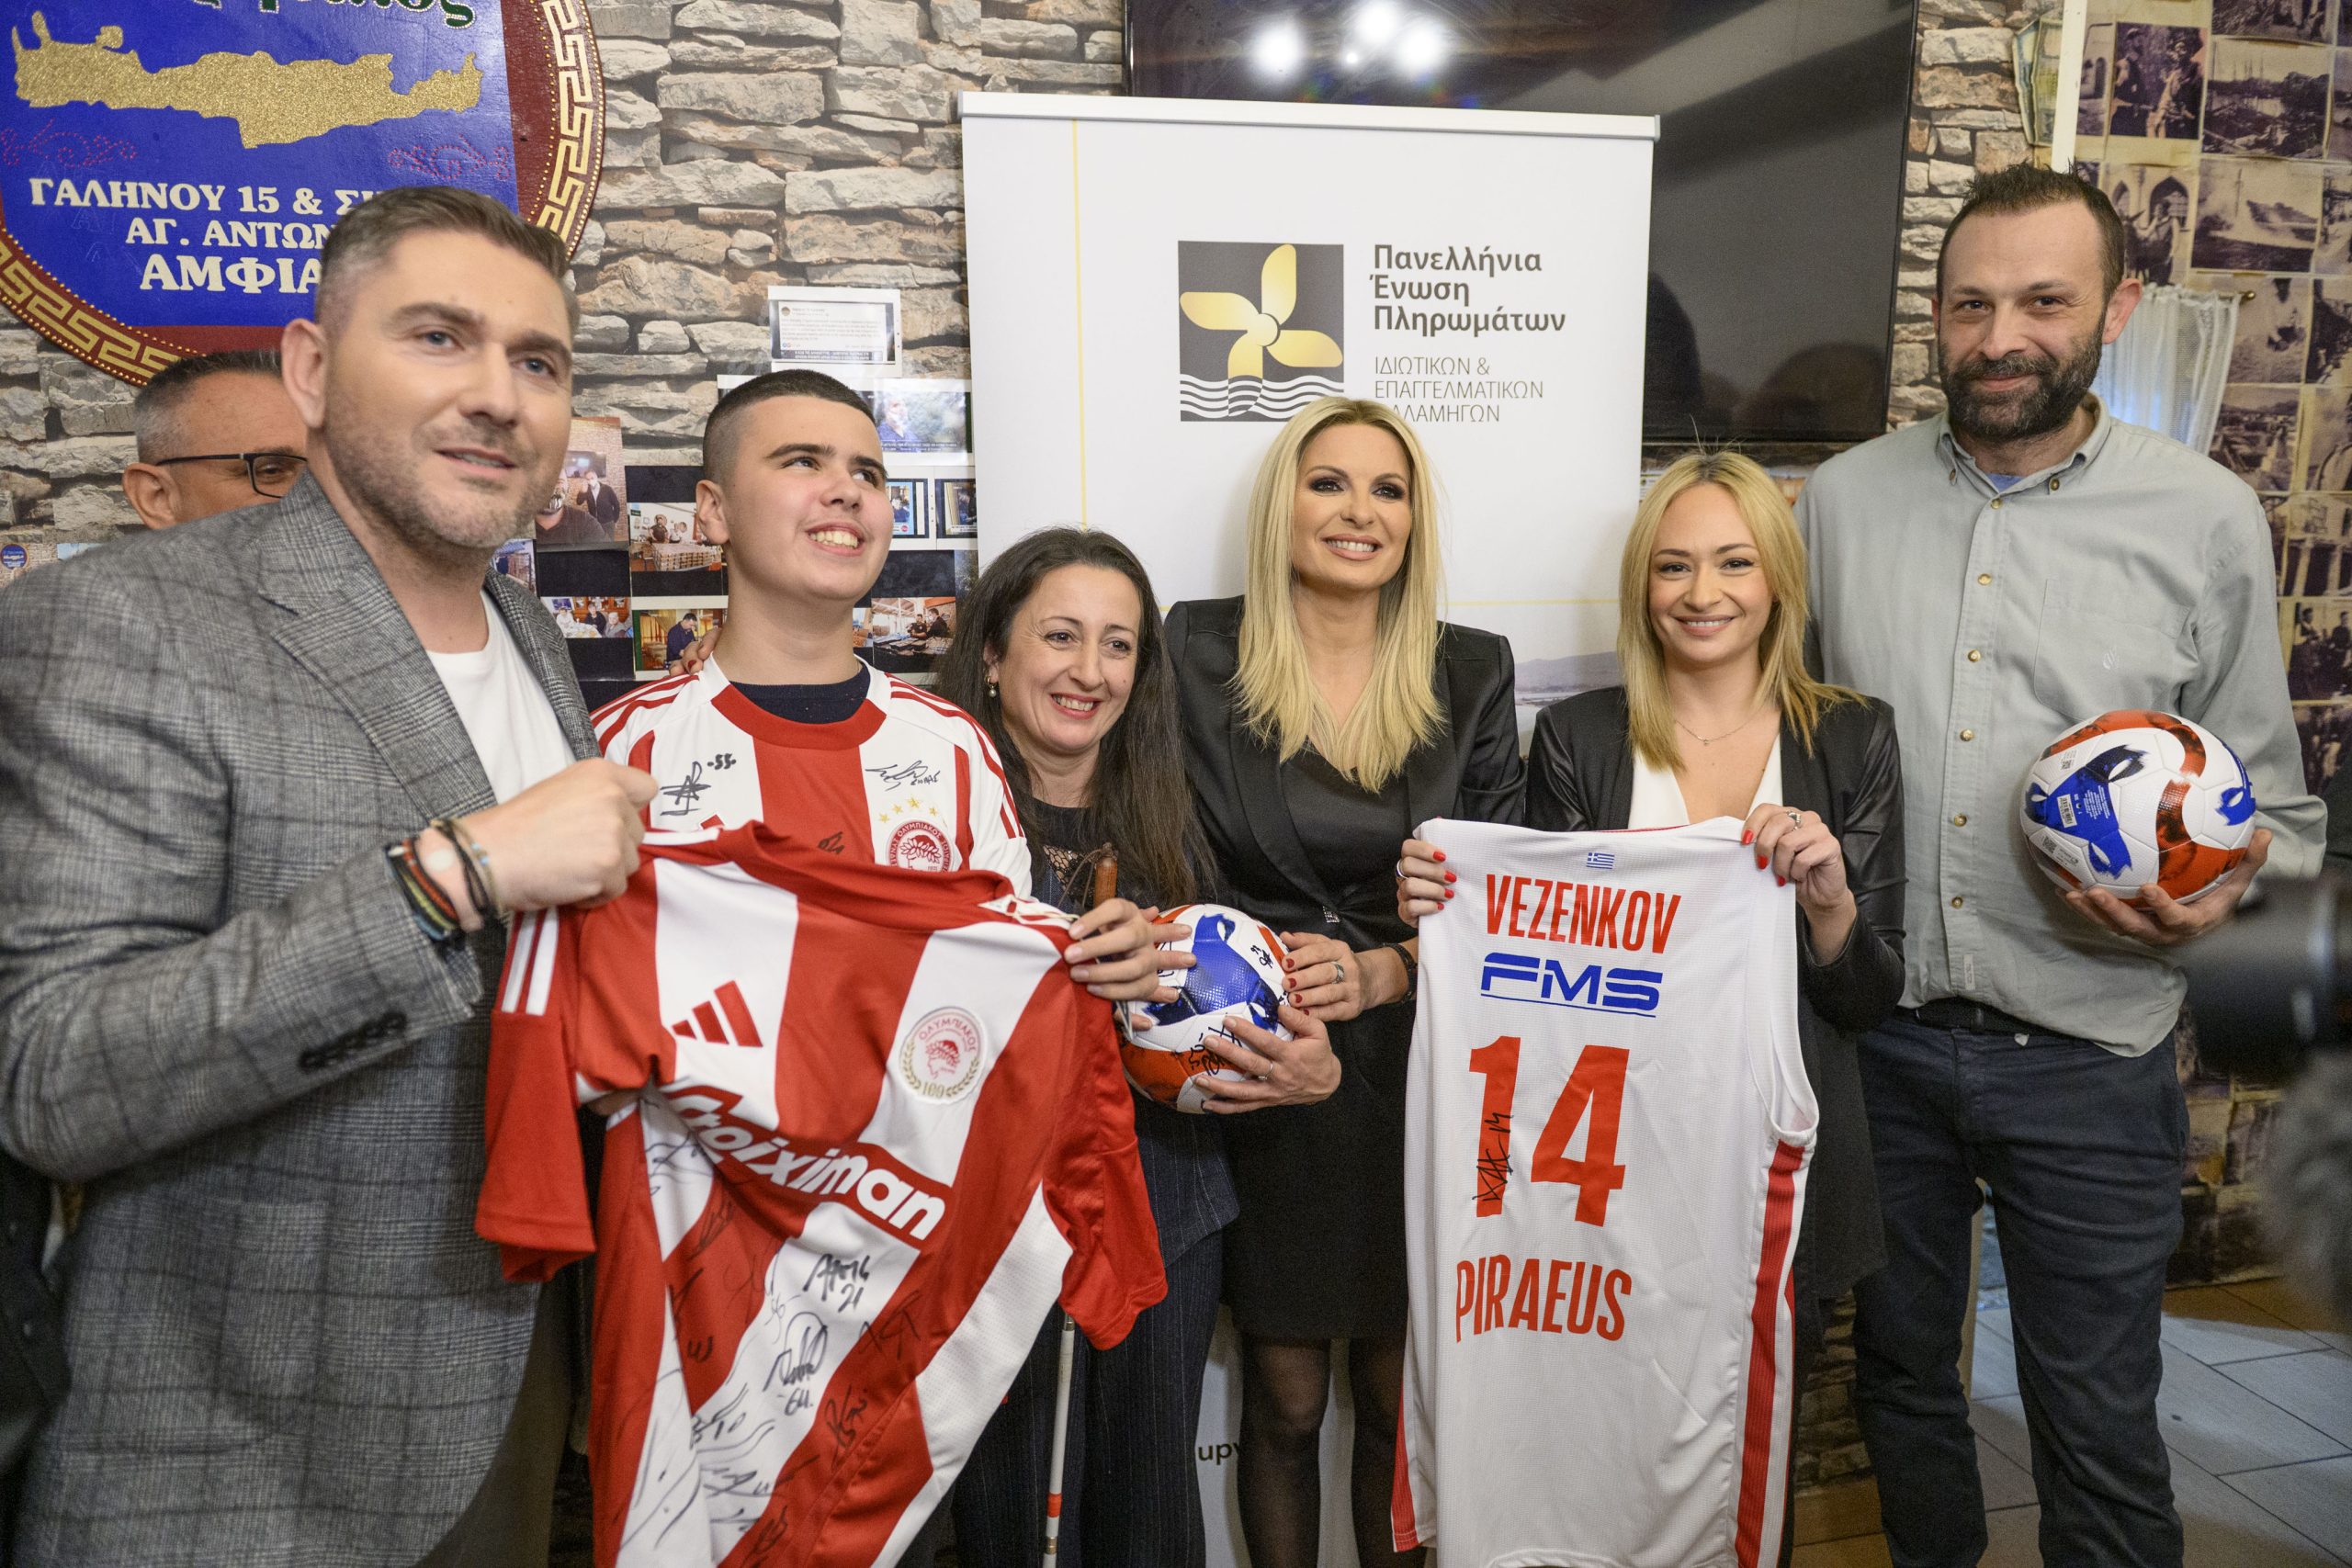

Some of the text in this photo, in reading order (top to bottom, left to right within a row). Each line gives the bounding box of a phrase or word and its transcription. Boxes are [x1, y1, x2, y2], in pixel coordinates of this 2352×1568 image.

[28, 177, 225, 211] ΓΑΛΗΝΟΥ
[238, 186, 280, 213] 15
[292, 187, 323, 215] &
[1374, 244, 1543, 277] Πανελλήνια
[1369, 274, 1470, 307] Ένωση
[1374, 305, 1566, 338] Πληρωμάτων
[1375, 356, 1490, 376] ΙΔΙΩΤΙΚΩΝ &
[1375, 380, 1544, 400] ΕΠΑΓΓΕΛΜΑΤΙΚΩΝ
[1486, 874, 1681, 953] VEZENKOV
[1480, 952, 1663, 1011] FMS
[922, 1082, 945, 1098] 100
[1469, 1035, 1630, 1227] 14
[1455, 1255, 1632, 1344] PIRAEUS
